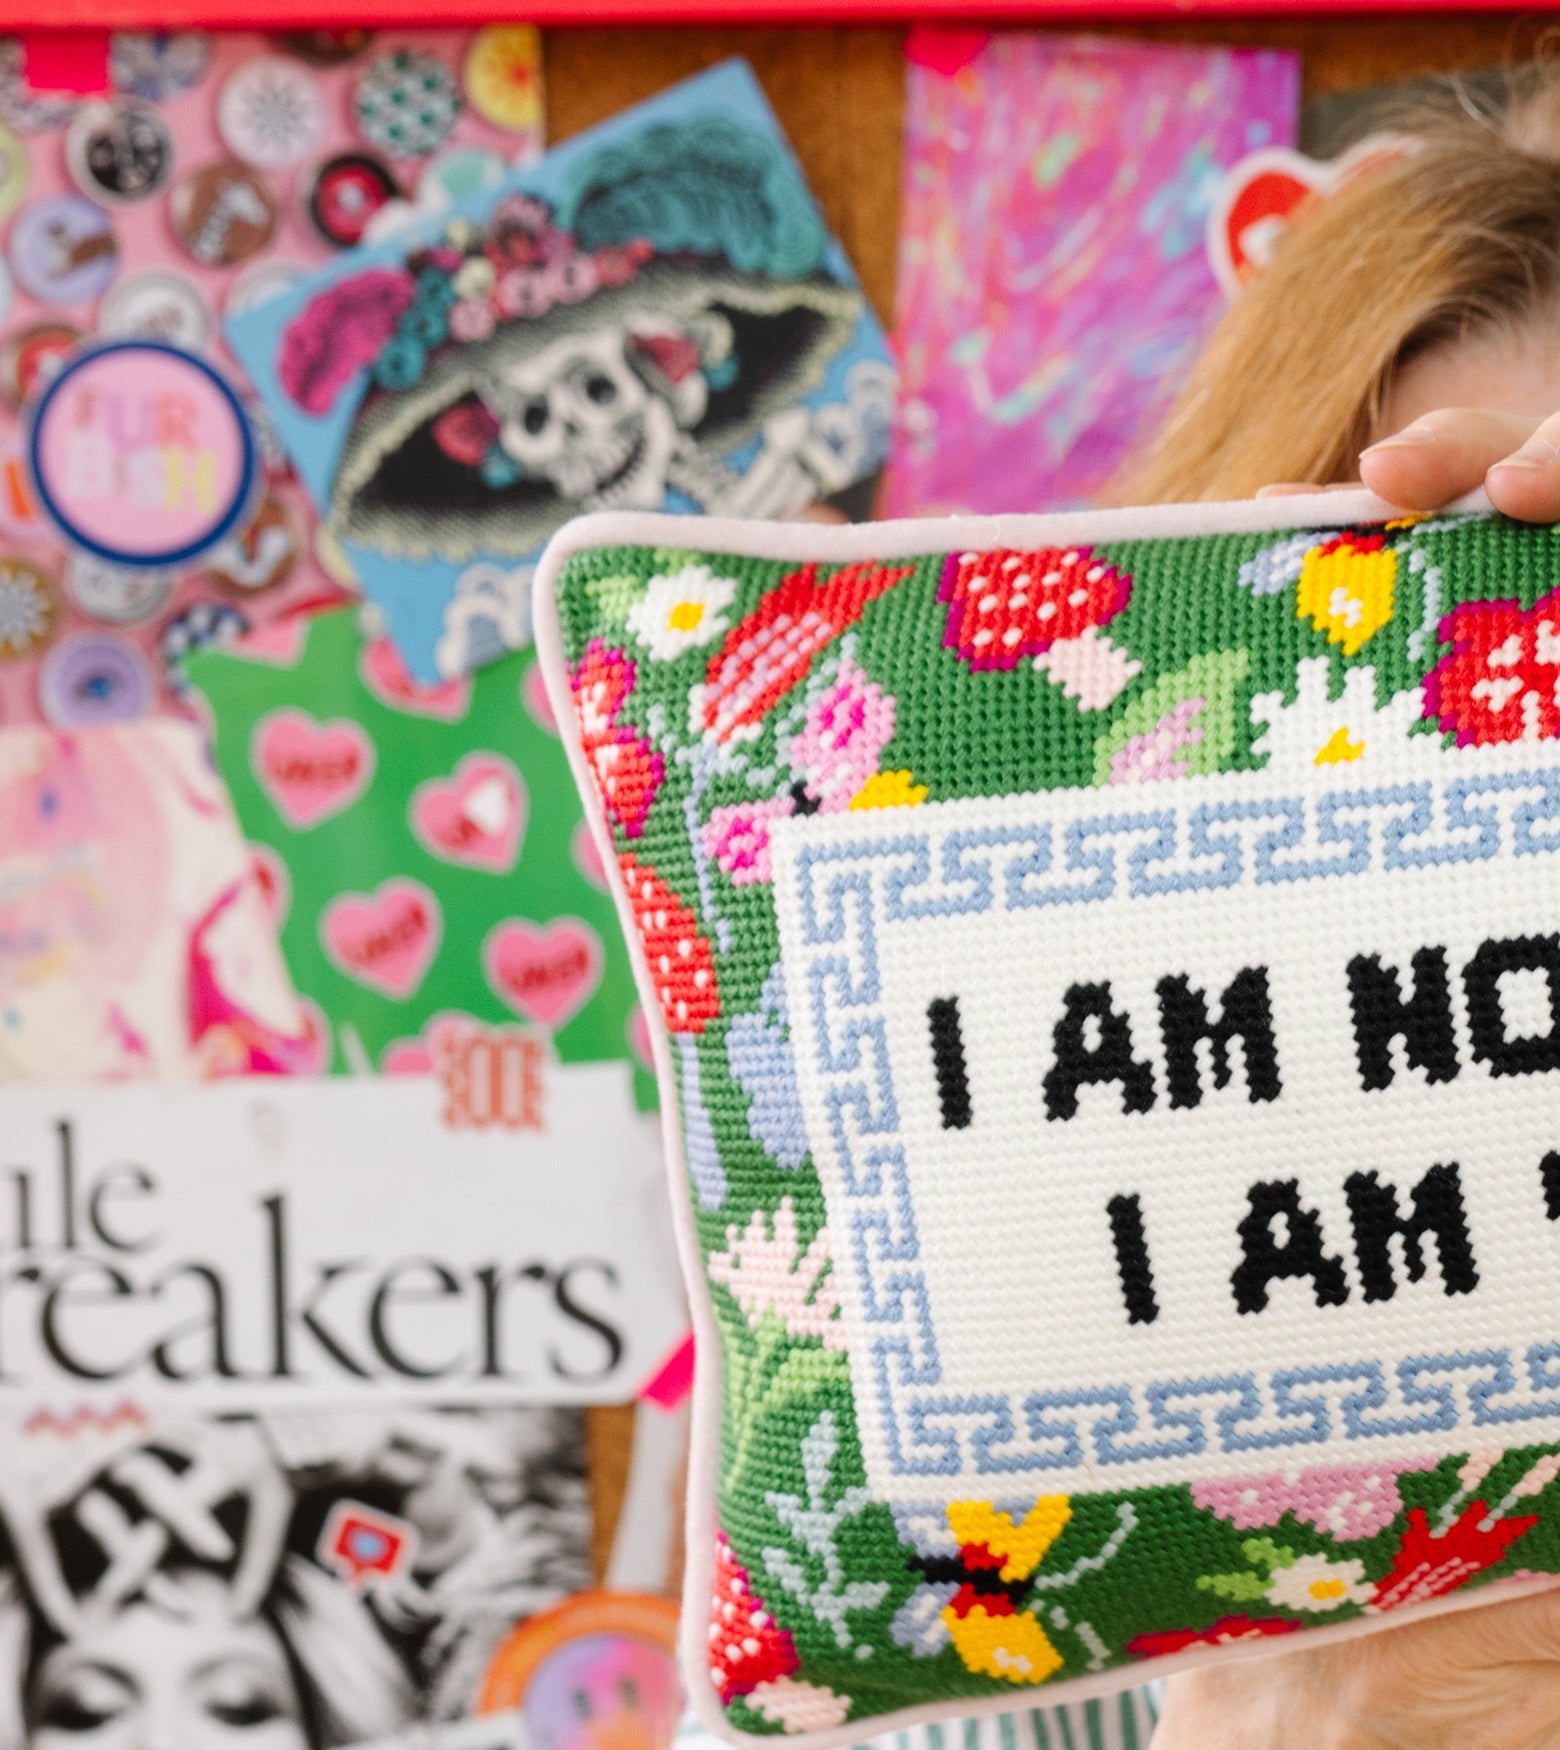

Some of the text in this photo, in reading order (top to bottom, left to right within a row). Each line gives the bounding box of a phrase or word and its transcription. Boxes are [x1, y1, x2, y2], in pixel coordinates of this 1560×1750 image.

[927, 997, 971, 1129] I
[1043, 966, 1282, 1121] AM
[1107, 1195, 1159, 1324] I
[1230, 1162, 1479, 1315] AM
